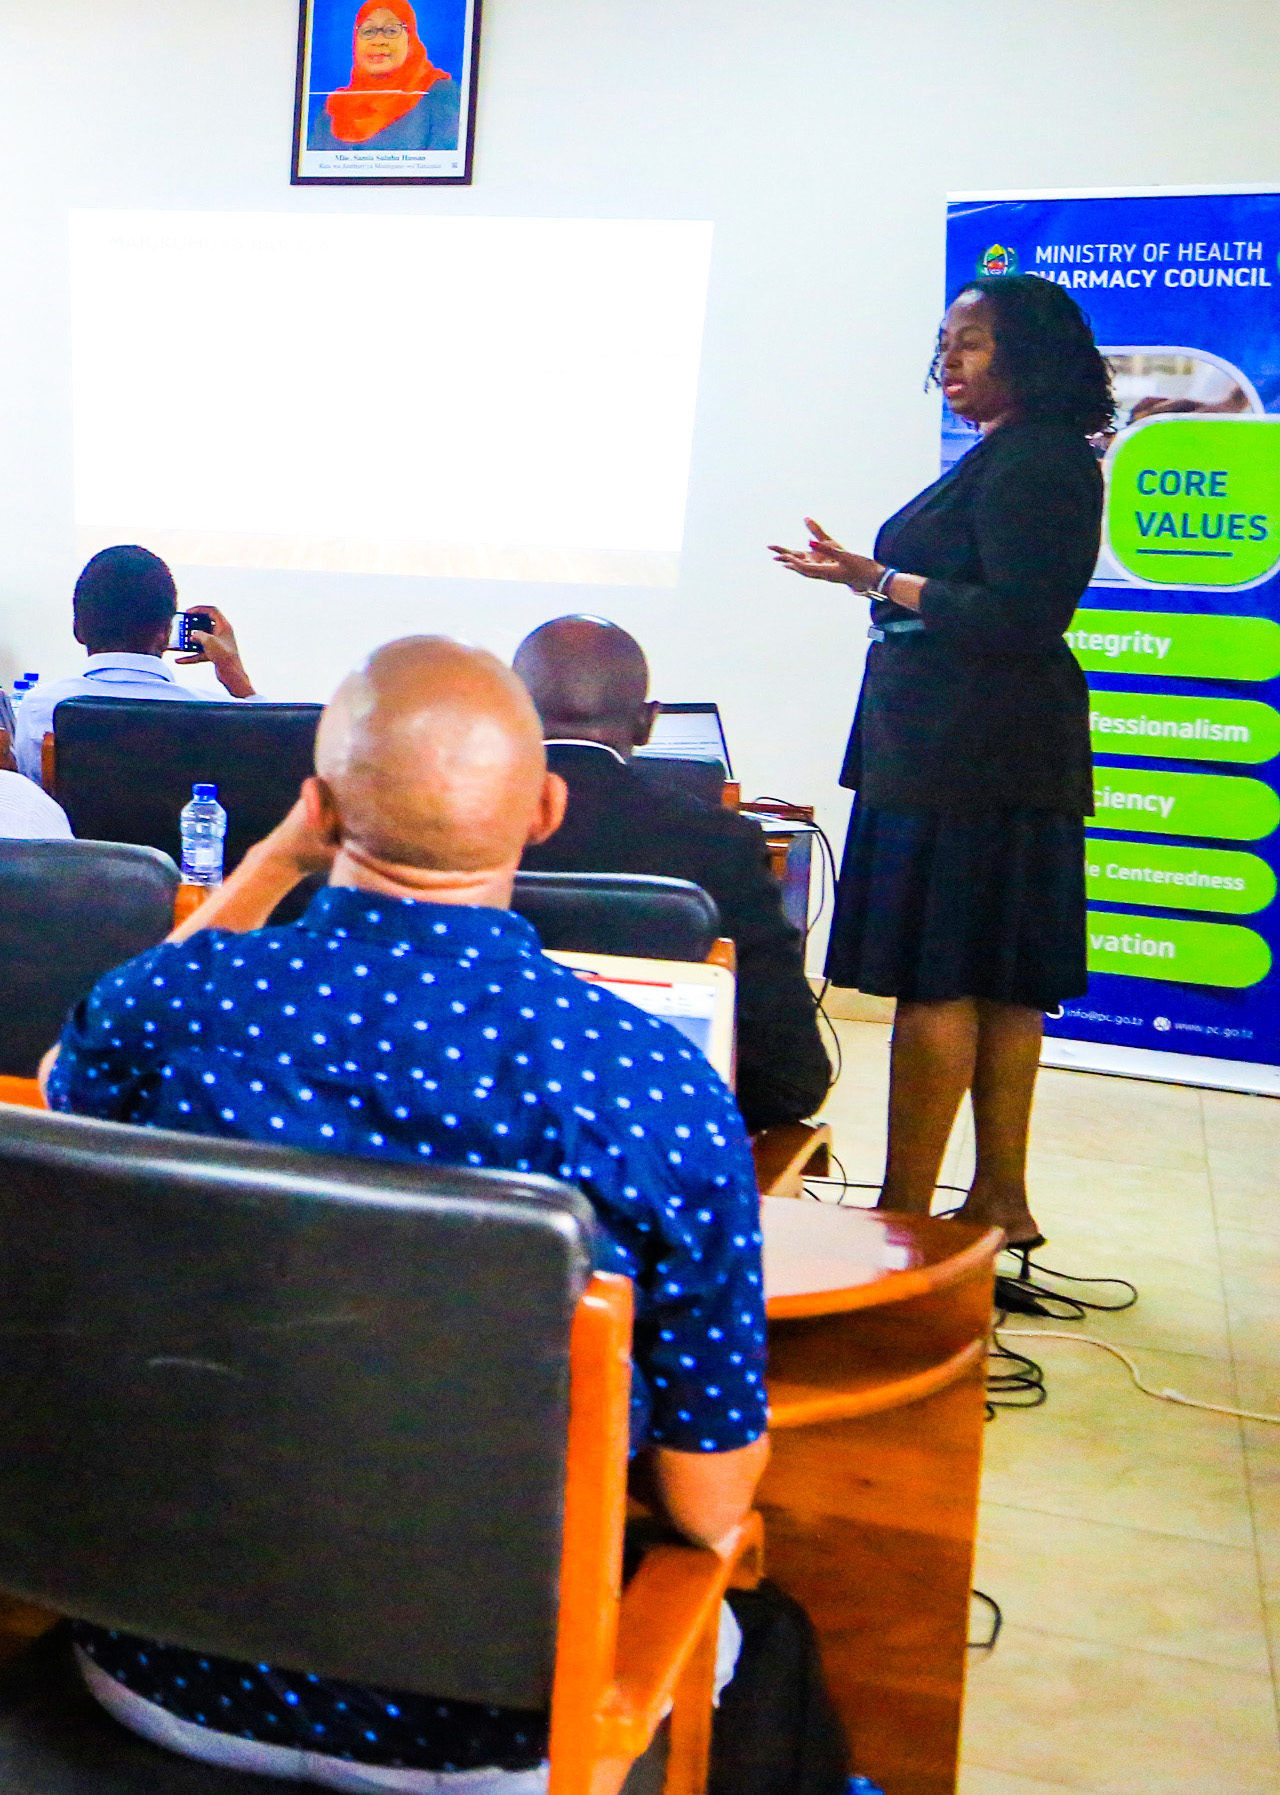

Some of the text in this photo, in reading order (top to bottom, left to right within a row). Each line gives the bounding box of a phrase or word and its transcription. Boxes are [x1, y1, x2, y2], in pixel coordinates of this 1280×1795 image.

[1035, 241, 1263, 264] MINISTRY OF HEALTH
[1164, 268, 1272, 288] COUNCIL
[1137, 468, 1228, 498] CORE
[1135, 510, 1269, 542] VALUES
[1064, 630, 1172, 659] ntegrity
[1089, 711, 1250, 743] fessionalism
[1094, 786, 1176, 819] ciency
[1106, 863, 1246, 891] Centeredness
[1090, 933, 1176, 959] vation
